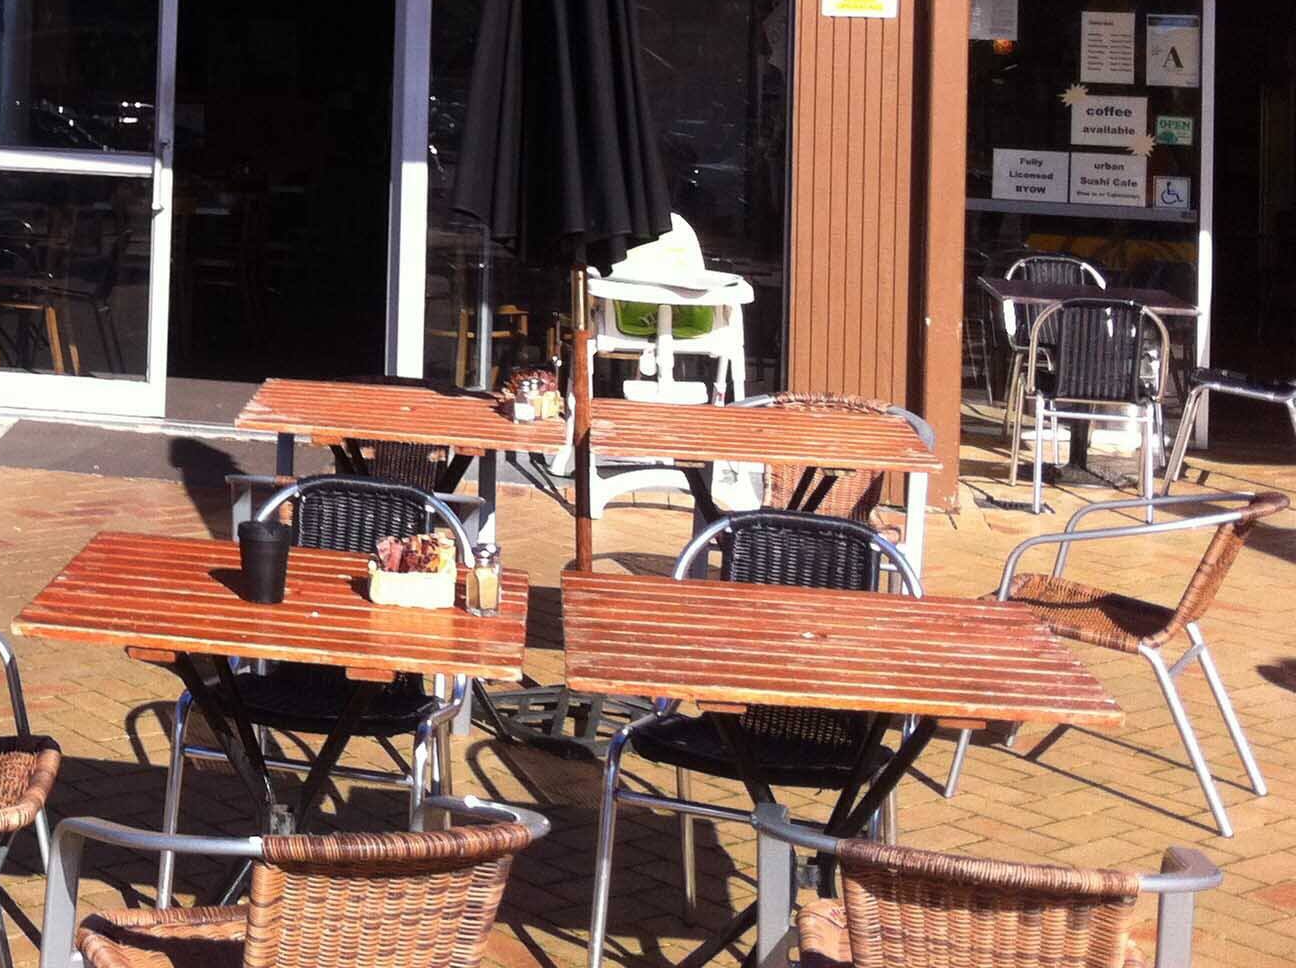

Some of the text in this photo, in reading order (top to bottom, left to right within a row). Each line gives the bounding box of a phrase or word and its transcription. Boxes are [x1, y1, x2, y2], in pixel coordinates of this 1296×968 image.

[1162, 45, 1184, 69] A
[1086, 105, 1133, 118] coffee
[1159, 119, 1191, 130] OPEN
[1083, 125, 1136, 136] available
[1079, 176, 1110, 187] Sushi
